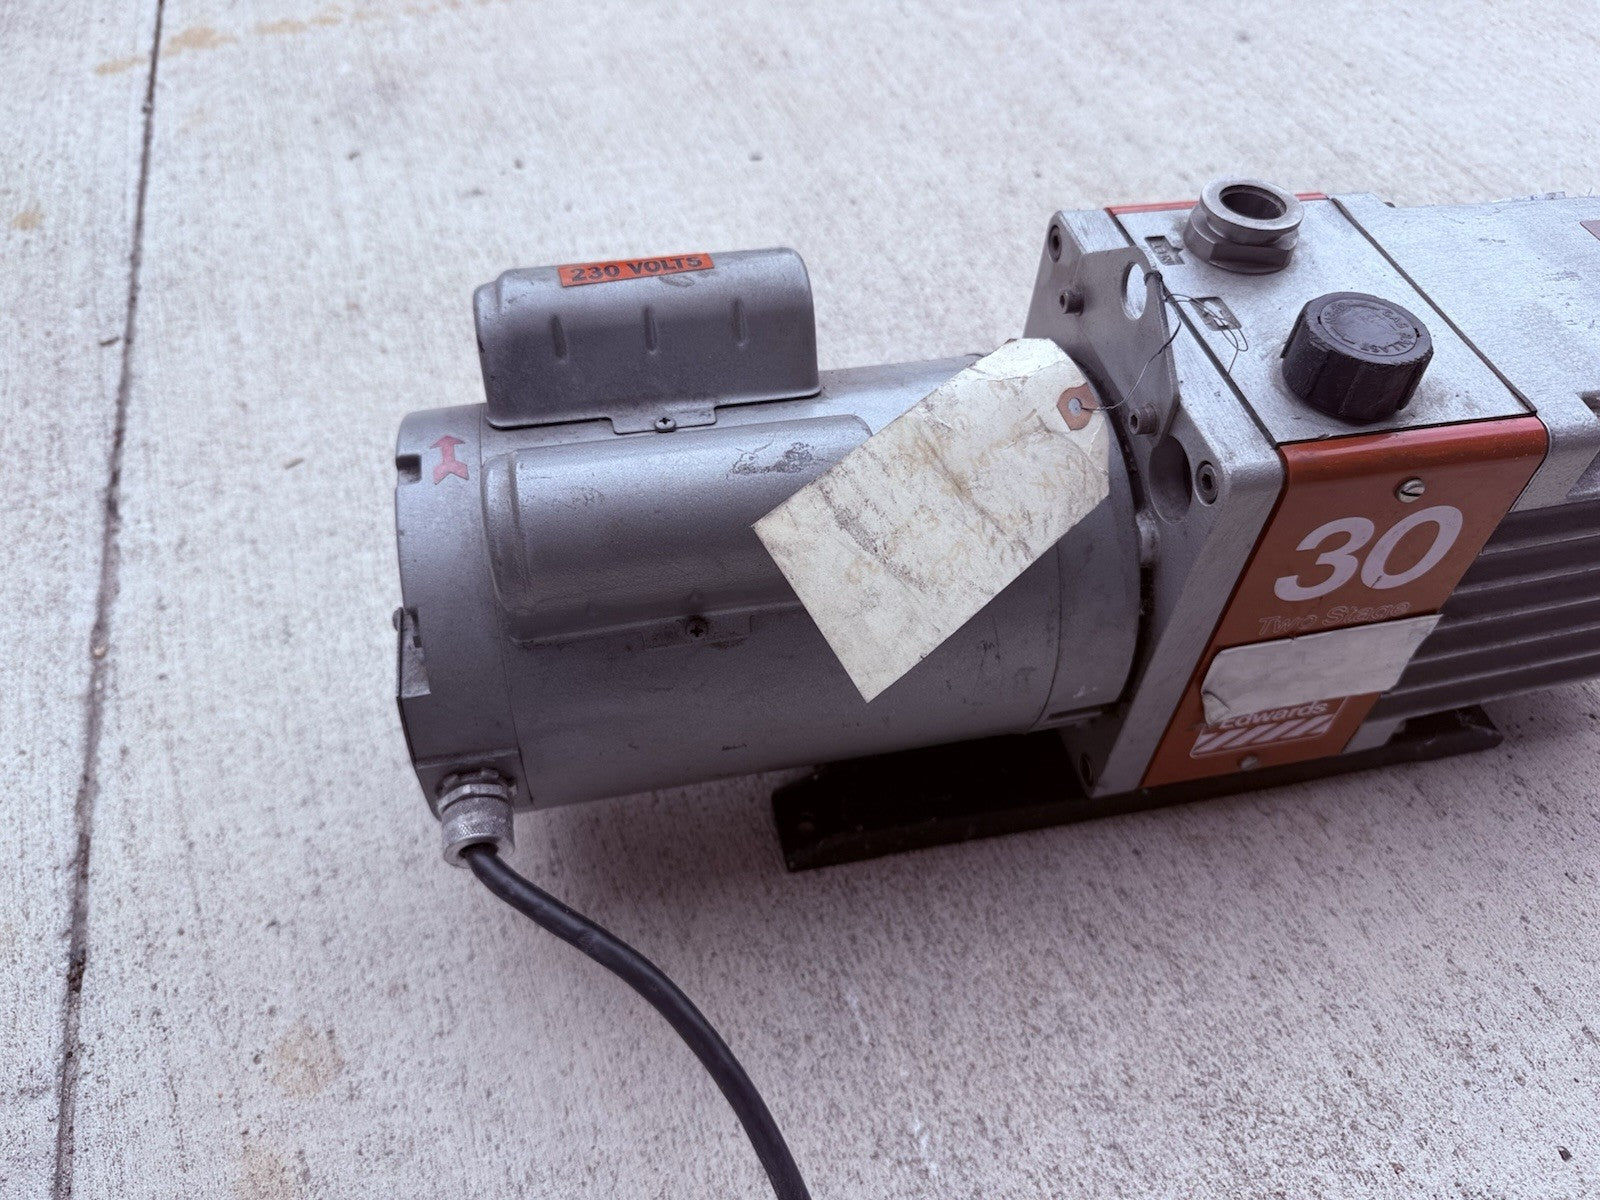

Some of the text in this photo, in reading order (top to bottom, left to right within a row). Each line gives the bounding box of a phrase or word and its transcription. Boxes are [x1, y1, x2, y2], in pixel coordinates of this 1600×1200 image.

[570, 256, 702, 282] 230 VOLTS
[1274, 505, 1464, 602] 30
[1258, 614, 1318, 636] Two
